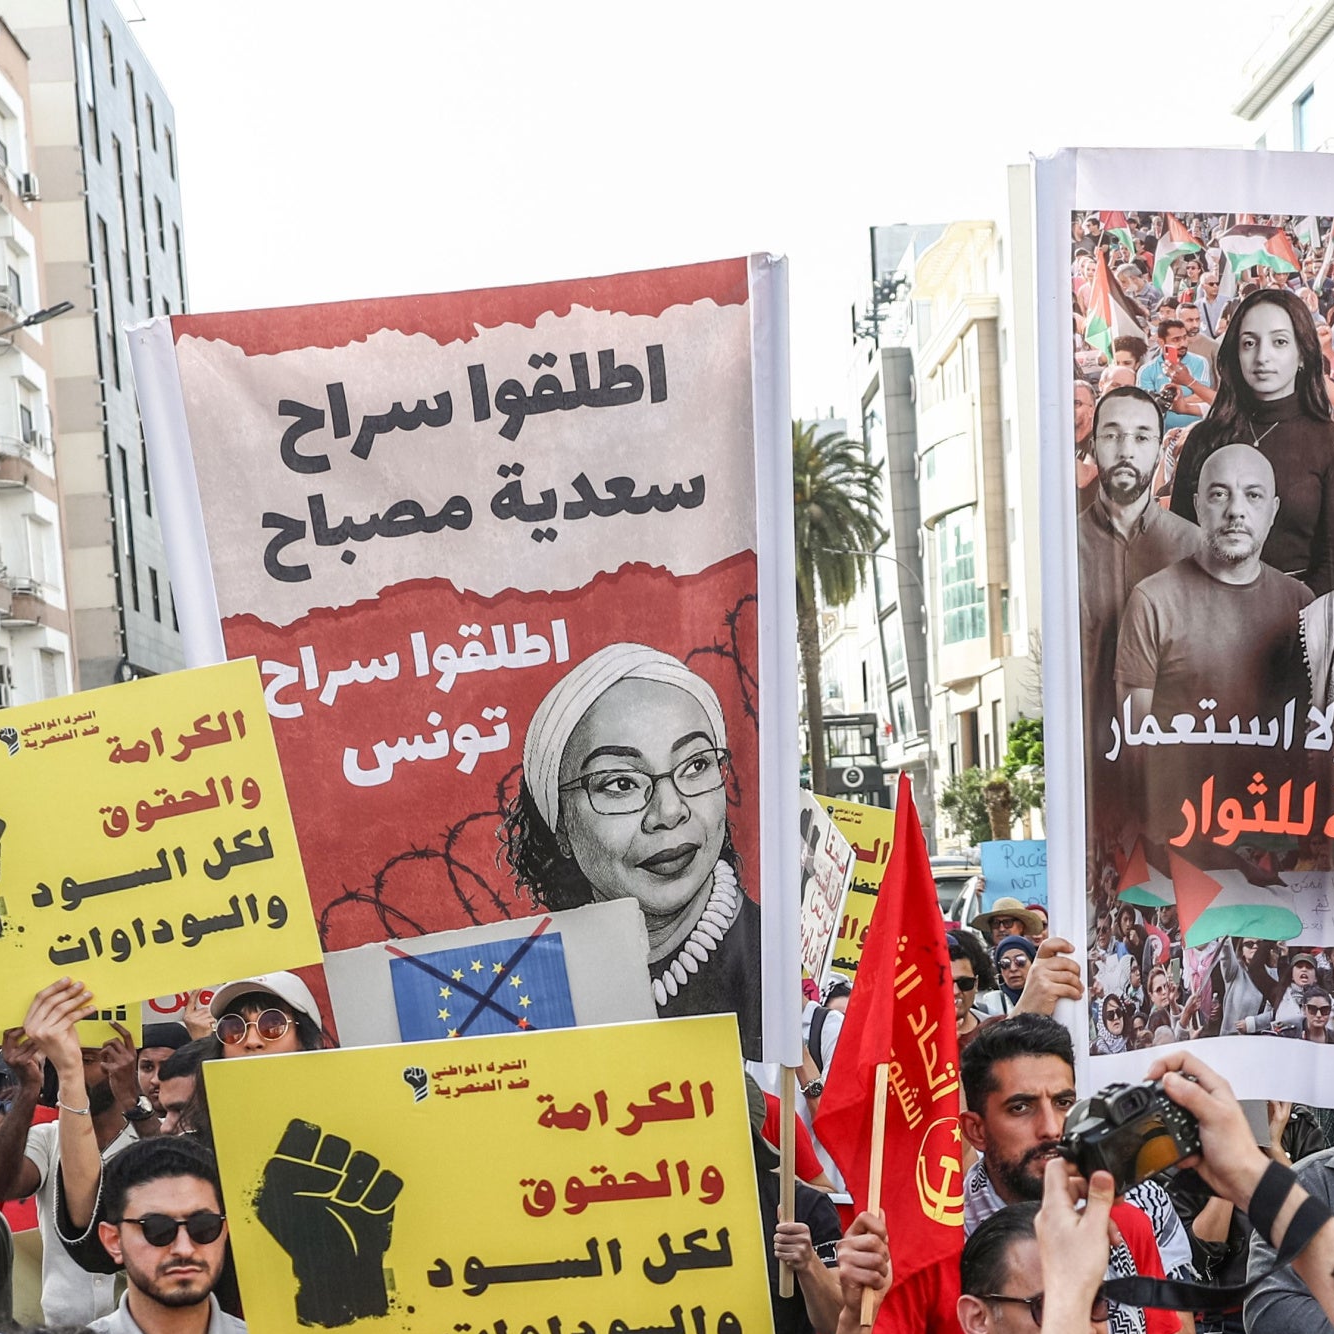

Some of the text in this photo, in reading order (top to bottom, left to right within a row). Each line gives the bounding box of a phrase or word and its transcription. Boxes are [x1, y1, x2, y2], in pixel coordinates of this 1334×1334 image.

[278, 345, 667, 474] اطلقوا سراح
[261, 462, 705, 582] سعدية مصباح
[260, 618, 570, 718] اطلقوا سراح
[24, 724, 100, 750] ضد العنصرية
[106, 709, 247, 766] الكرامة
[342, 704, 510, 786] تونس
[1104, 694, 1296, 763] استعمار
[99, 775, 262, 839] والحقوق
[1169, 771, 1317, 848] للثوار
[30, 826, 275, 913] لكل السود
[1001, 843, 1047, 868] Racis
[47, 894, 288, 967] والسوداوات
[431, 1059, 527, 1081] التحرك المواطني
[434, 1077, 530, 1099] ضد العنصرية
[537, 1080, 715, 1136] الكرامة
[520, 1159, 725, 1218] والحقوق
[426, 1226, 733, 1296] لكل السود
